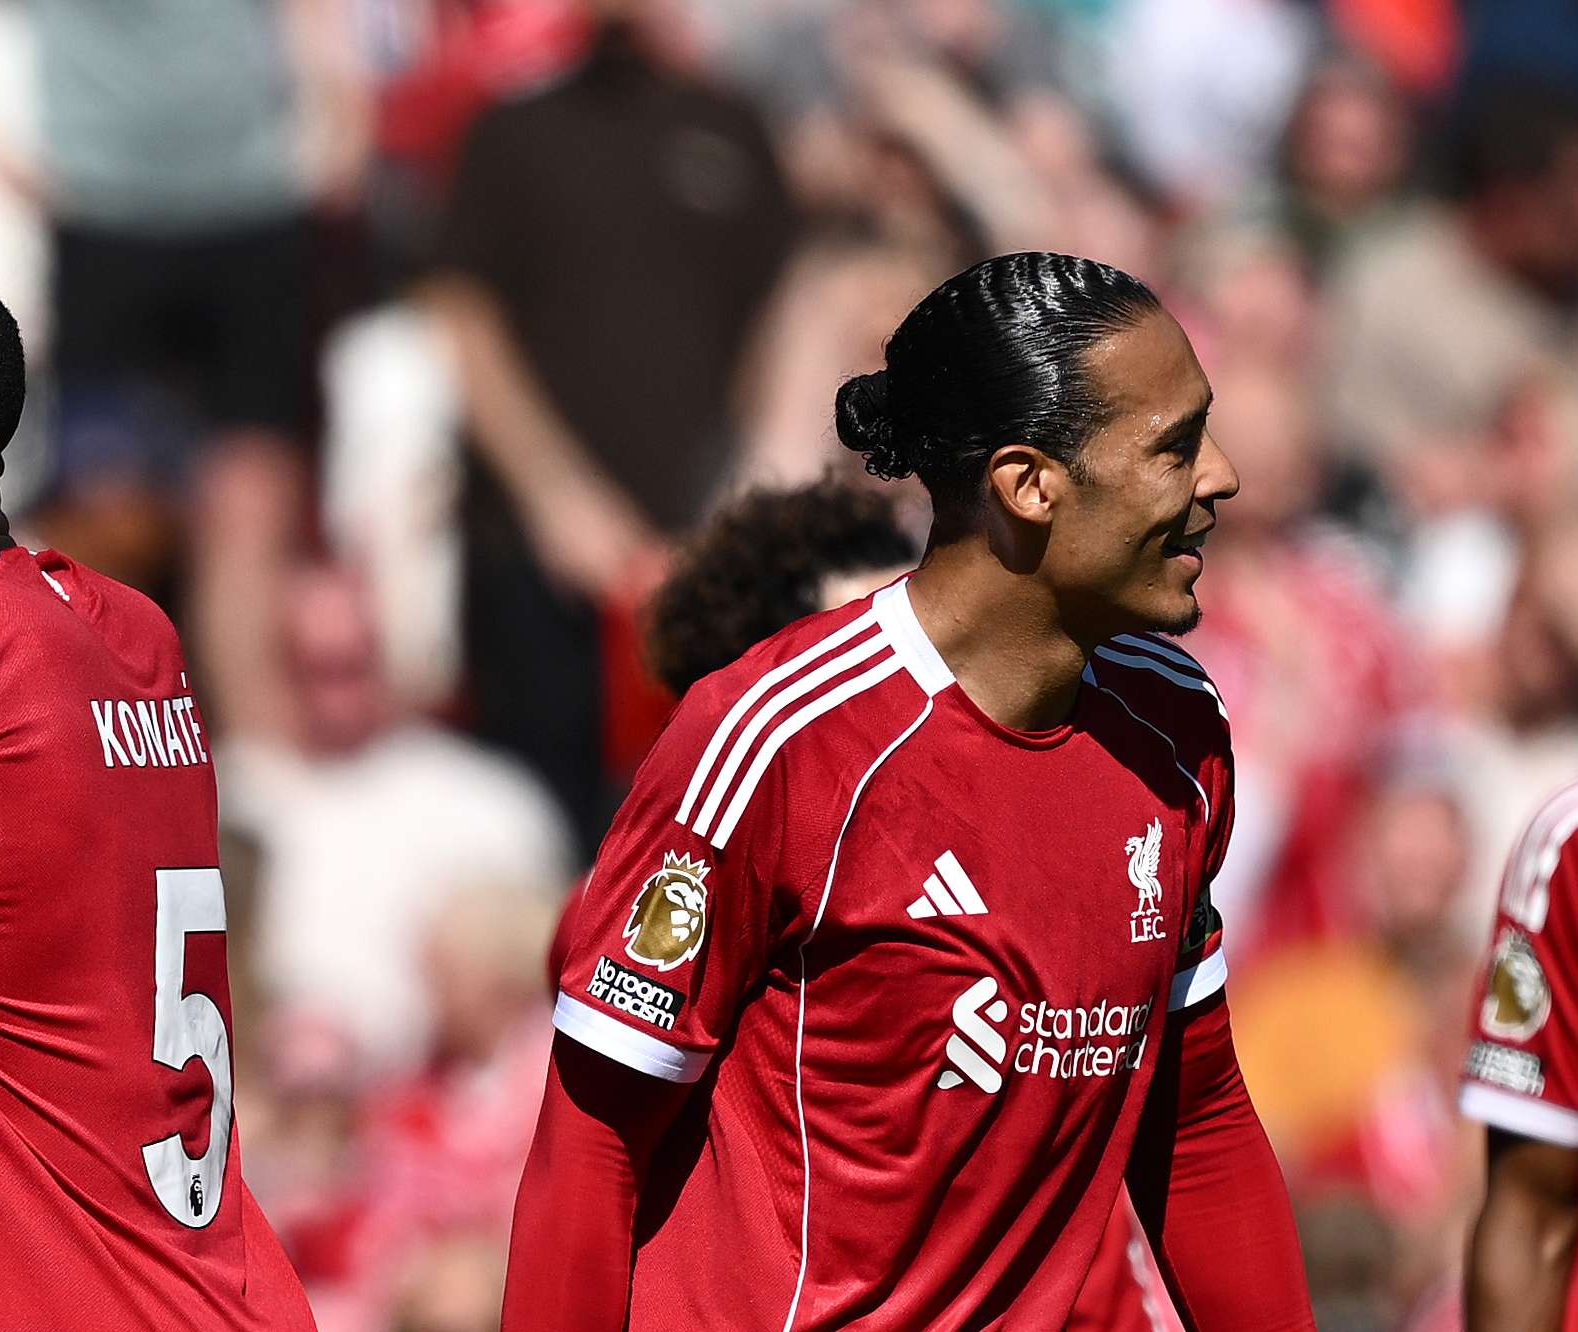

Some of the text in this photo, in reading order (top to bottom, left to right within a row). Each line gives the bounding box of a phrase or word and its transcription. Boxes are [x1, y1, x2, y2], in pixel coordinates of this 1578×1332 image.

[89, 671, 207, 767] KONATÉ
[594, 956, 673, 1010] No room
[605, 987, 675, 1031] racism
[1019, 995, 1153, 1040] standard
[141, 868, 232, 1229] 5
[1014, 1034, 1148, 1079] charterd
